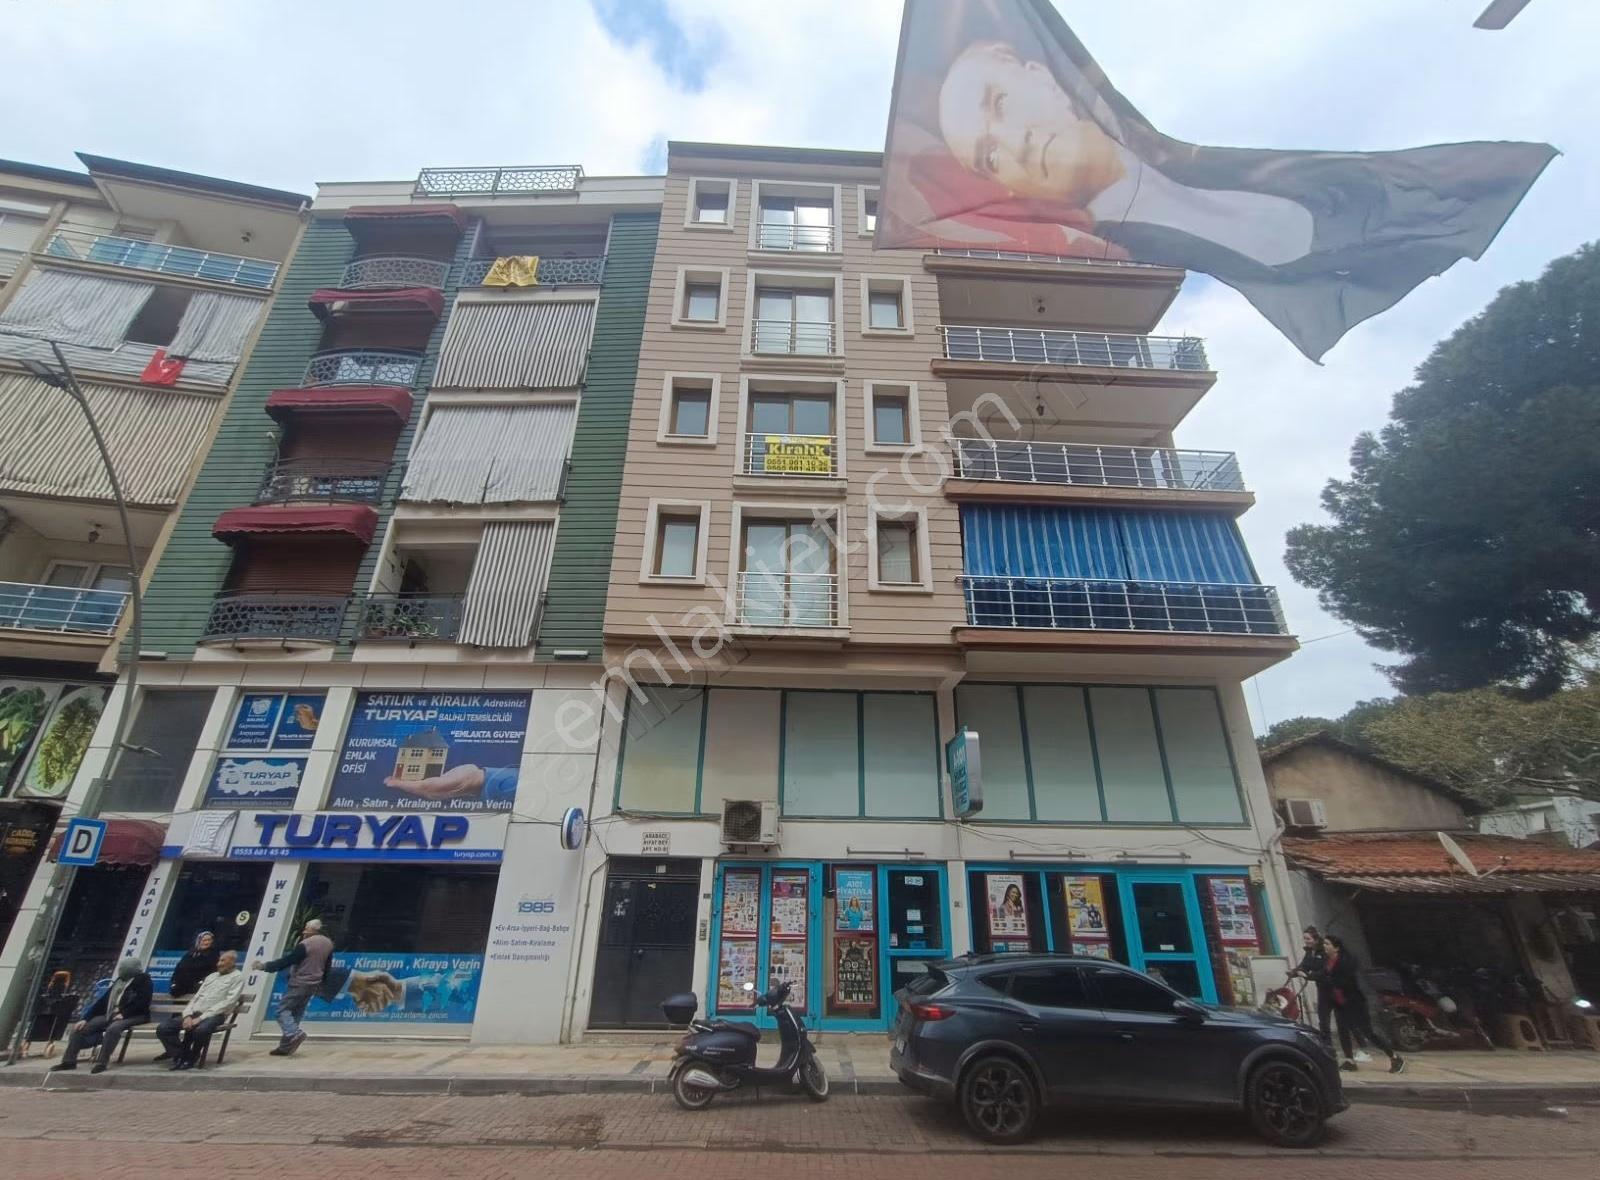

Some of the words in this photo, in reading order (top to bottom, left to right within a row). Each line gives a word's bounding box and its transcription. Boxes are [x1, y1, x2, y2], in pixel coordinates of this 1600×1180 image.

[769, 442, 825, 456] Kiralık
[367, 695, 414, 706] SATILIK
[431, 693, 481, 707] KİRALIK
[365, 709, 439, 721] TURYAP
[348, 738, 398, 748] KURUMSAL
[345, 751, 377, 760] EMLAK
[341, 762, 367, 774] OFİSİ
[243, 771, 291, 779] TURYAP
[450, 799, 483, 810] Kiraya
[486, 799, 512, 809] Verin
[254, 813, 469, 849] TURYAP
[72, 829, 92, 853] D
[140, 877, 161, 917] TAPU
[267, 879, 288, 918] WEB
[518, 902, 555, 913] 1985
[248, 931, 270, 986] TAU
[412, 958, 448, 971] Kiraya
[452, 958, 480, 969] Verin
[343, 1008, 368, 1019] büyük
